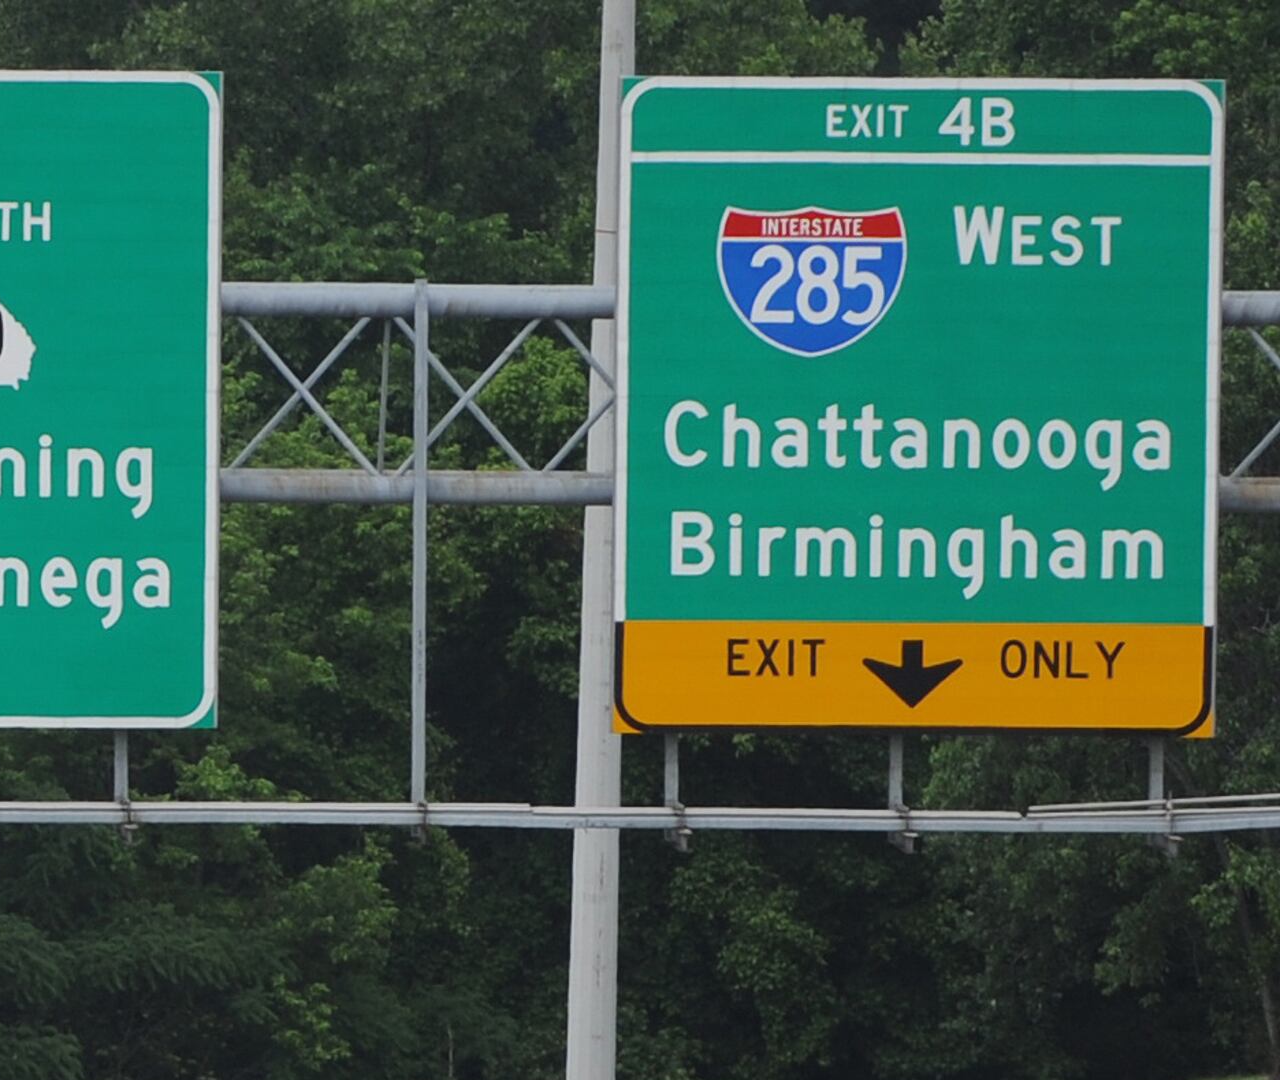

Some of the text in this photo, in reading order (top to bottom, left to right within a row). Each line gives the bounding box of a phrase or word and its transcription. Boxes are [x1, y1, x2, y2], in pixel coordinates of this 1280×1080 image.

[825, 97, 1016, 147] EXIT 4B
[760, 217, 864, 238] INTERSTATE
[749, 244, 885, 326] 285
[663, 400, 1171, 491] Chattanooga
[670, 511, 1164, 600] Birmingham
[726, 639, 1126, 680] EXIT ONLY
